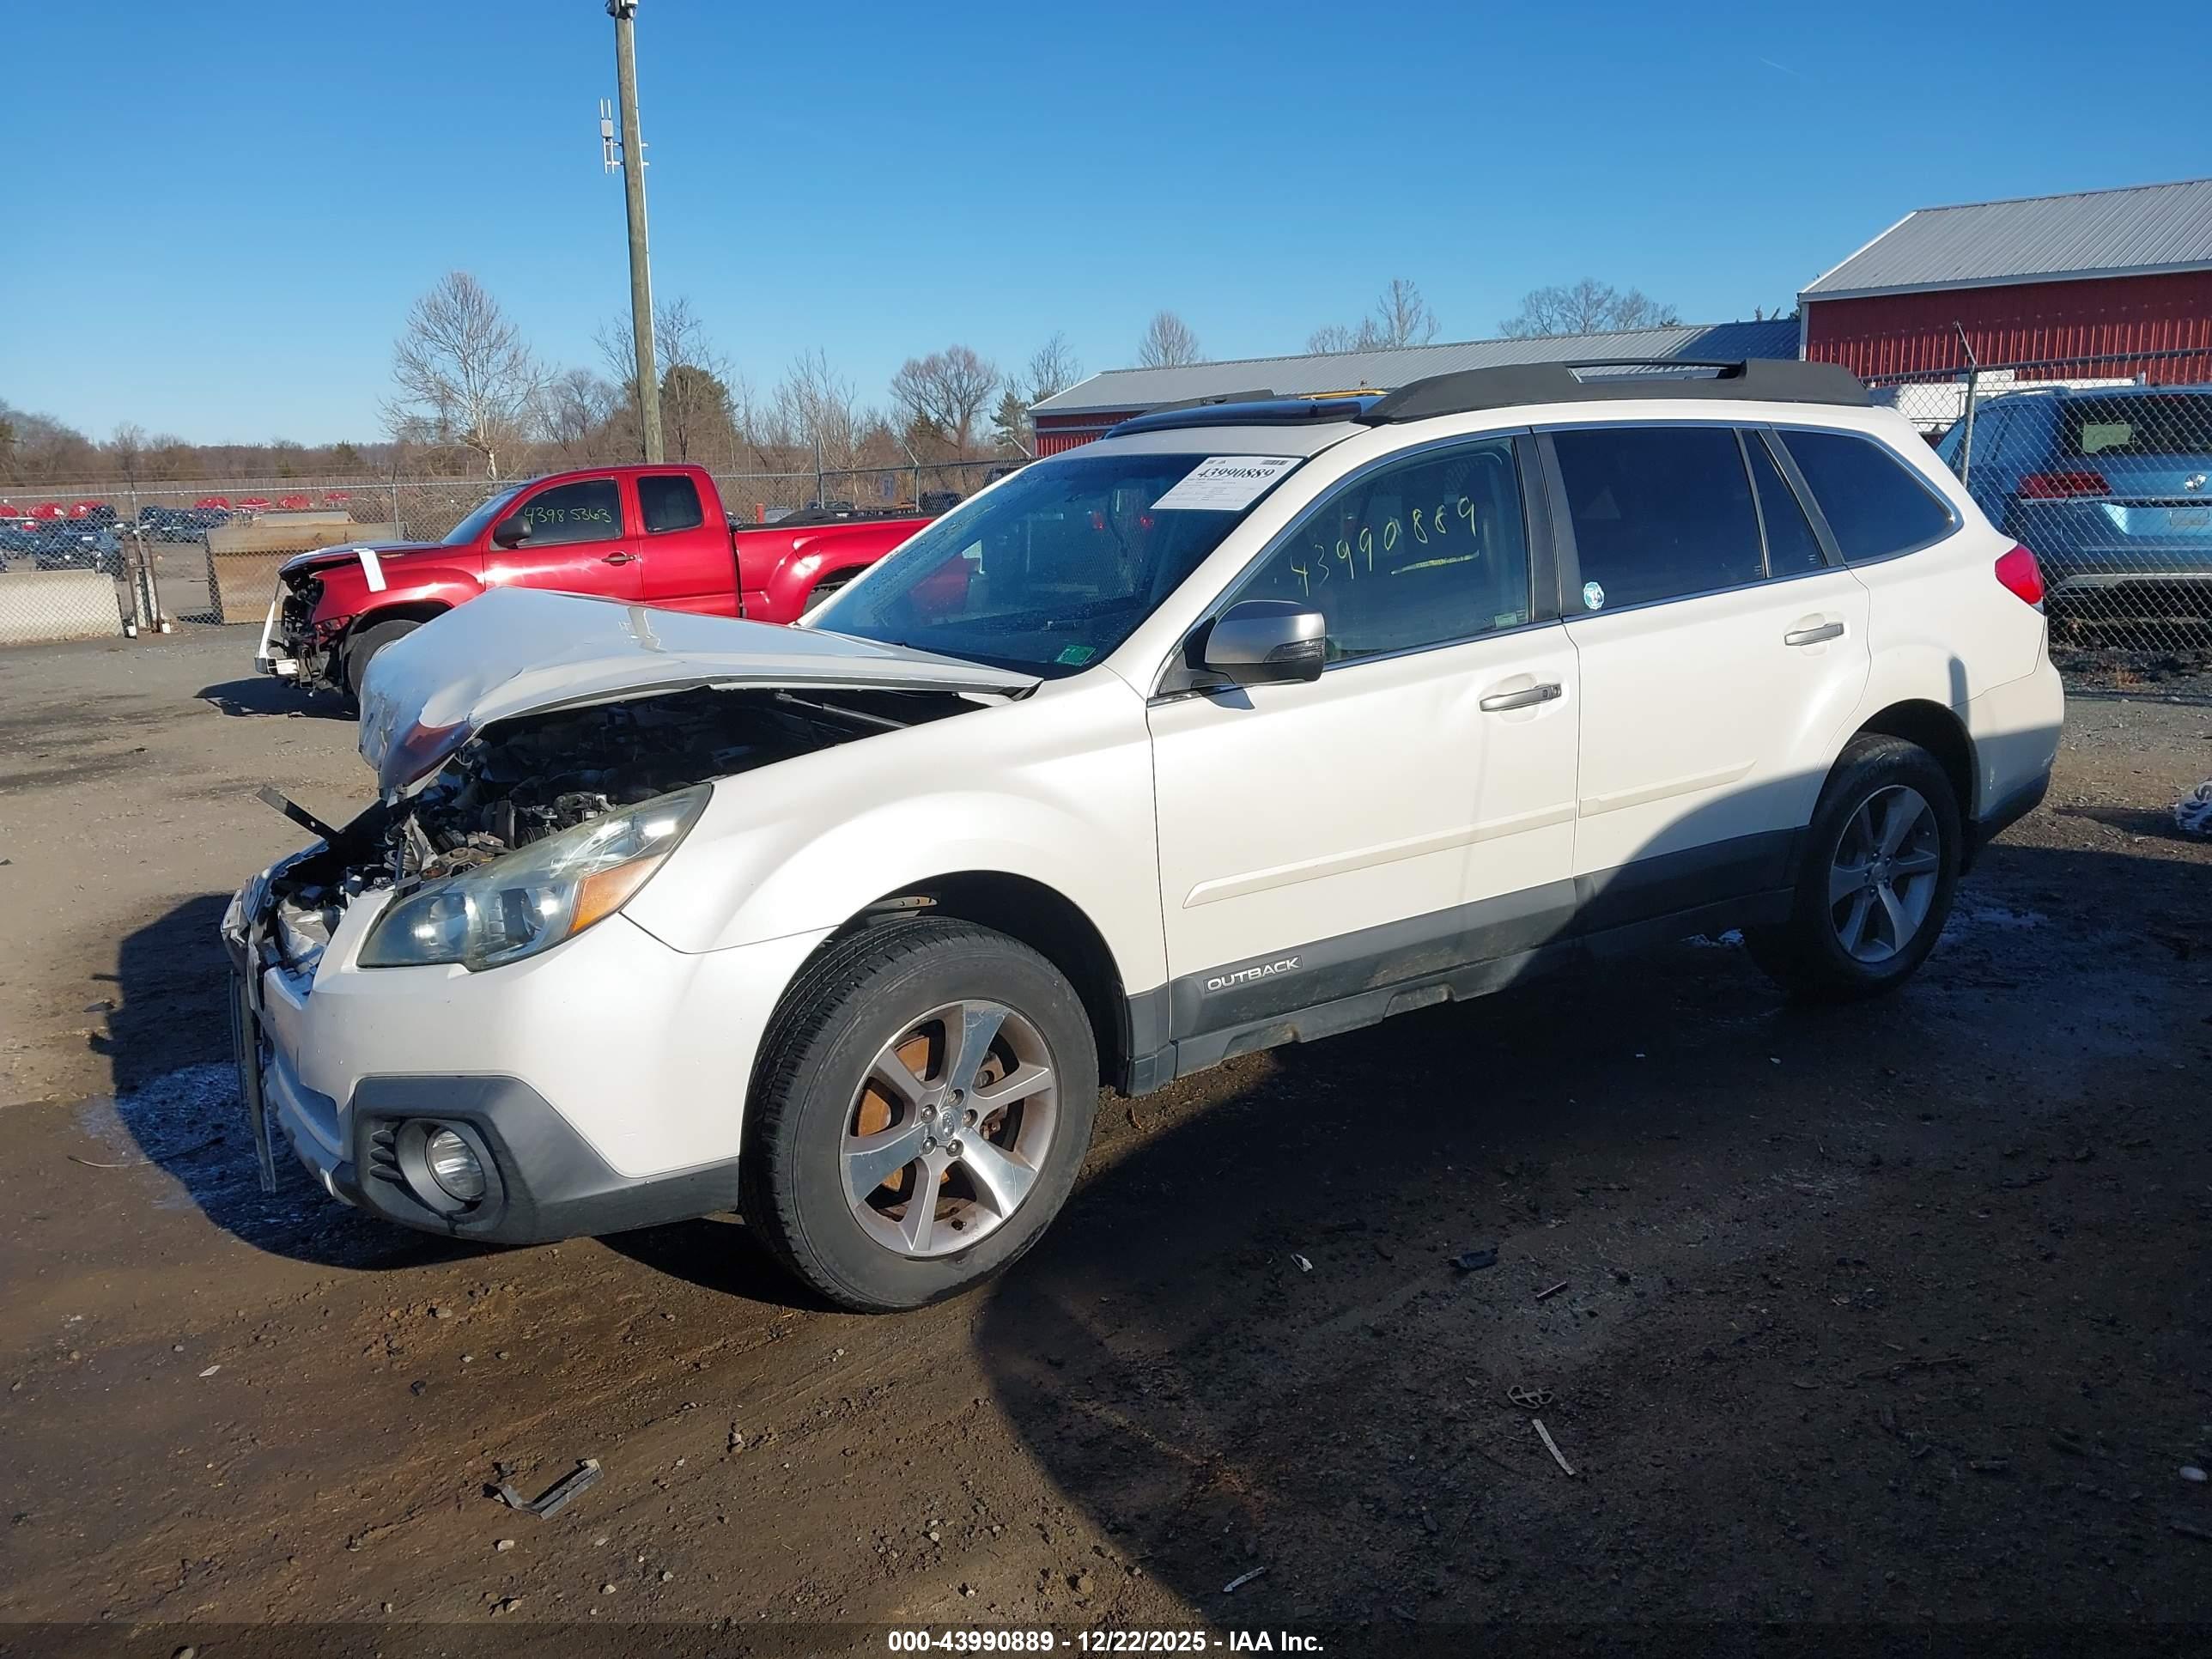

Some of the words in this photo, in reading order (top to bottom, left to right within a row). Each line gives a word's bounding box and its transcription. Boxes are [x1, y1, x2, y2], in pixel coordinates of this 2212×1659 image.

[1198, 467, 1276, 479] 43990889
[1290, 495, 1476, 597] 43990889
[1207, 957, 1300, 991] OUTBACK
